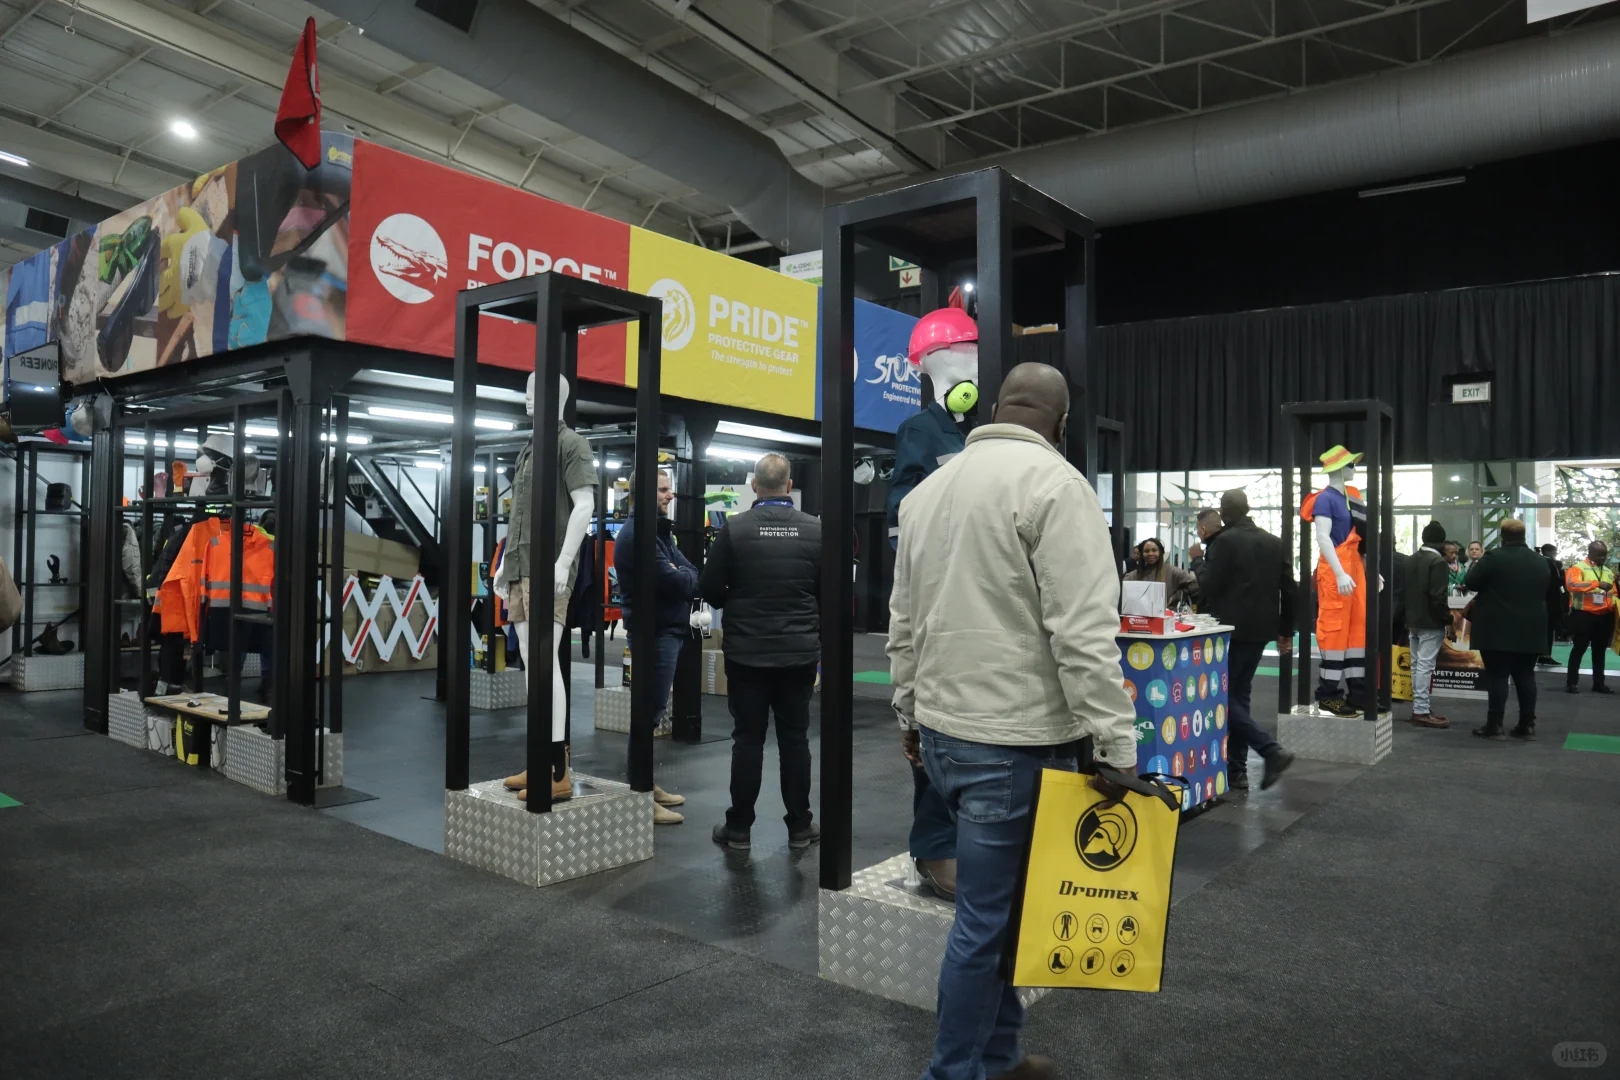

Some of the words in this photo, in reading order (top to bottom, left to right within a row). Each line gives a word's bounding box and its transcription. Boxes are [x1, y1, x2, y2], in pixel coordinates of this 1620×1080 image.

[708, 333, 771, 358] PROTECTIVE
[773, 348, 799, 364] GEAR
[711, 350, 725, 362] The
[726, 355, 757, 369] strength
[759, 361, 767, 371] to
[768, 364, 793, 376] protect
[865, 353, 921, 384] STOR
[883, 390, 910, 404] Engineered
[911, 397, 916, 405] to
[1462, 387, 1480, 398] EXIT
[1059, 880, 1139, 901] Dromex
